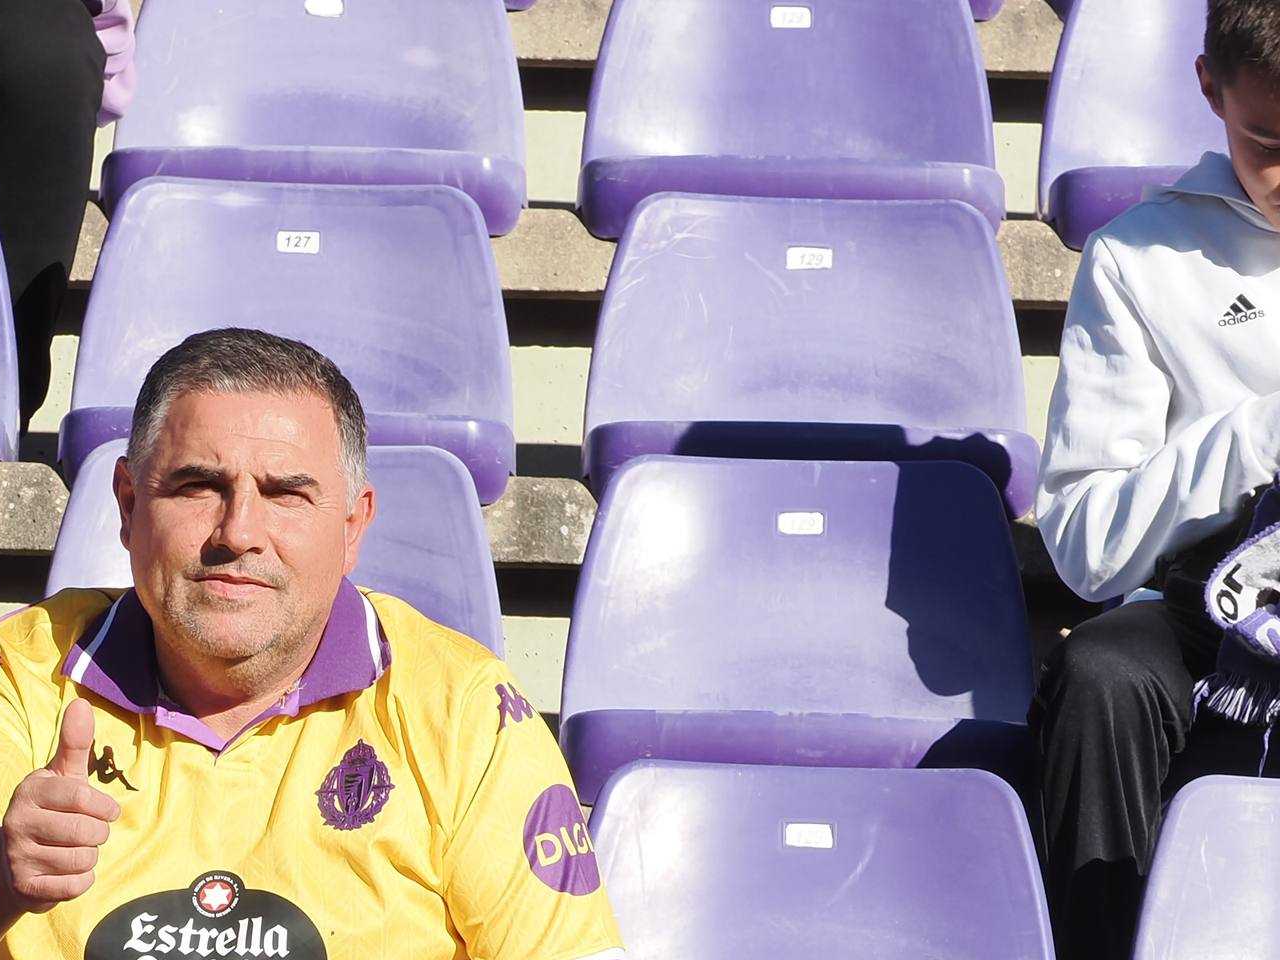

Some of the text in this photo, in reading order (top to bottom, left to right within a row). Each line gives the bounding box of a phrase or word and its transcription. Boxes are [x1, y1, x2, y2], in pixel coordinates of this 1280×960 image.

[283, 235, 311, 248] 127
[799, 253, 824, 266] 129
[1218, 309, 1265, 327] adidas
[535, 822, 595, 867] DIGI
[123, 911, 290, 958] Estrella
